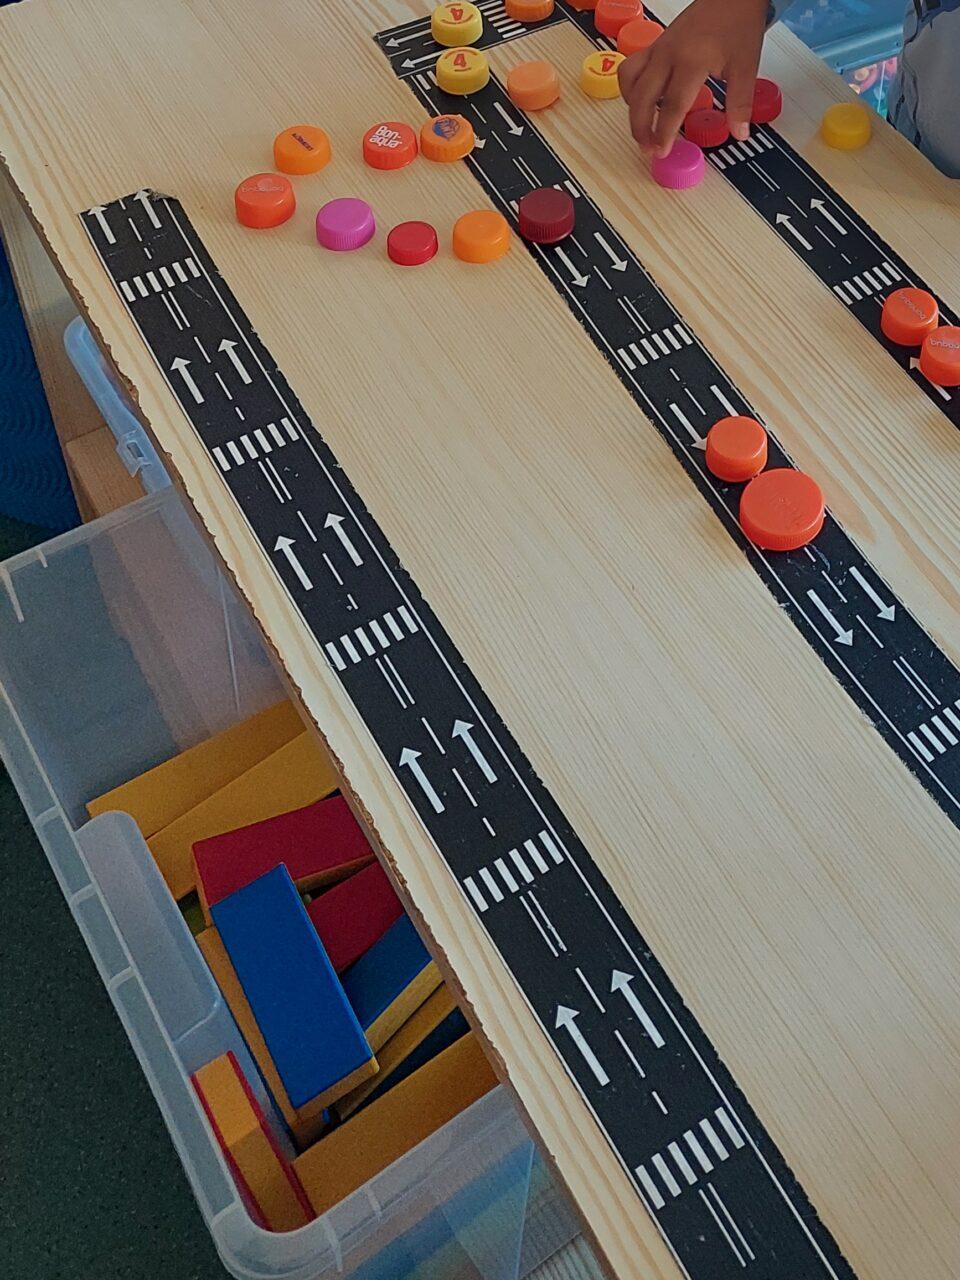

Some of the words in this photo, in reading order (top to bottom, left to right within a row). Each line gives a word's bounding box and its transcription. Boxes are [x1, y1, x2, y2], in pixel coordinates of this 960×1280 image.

[453, 53, 467, 67] 4
[374, 125, 402, 140] Bon-
[369, 133, 402, 149] aqua
